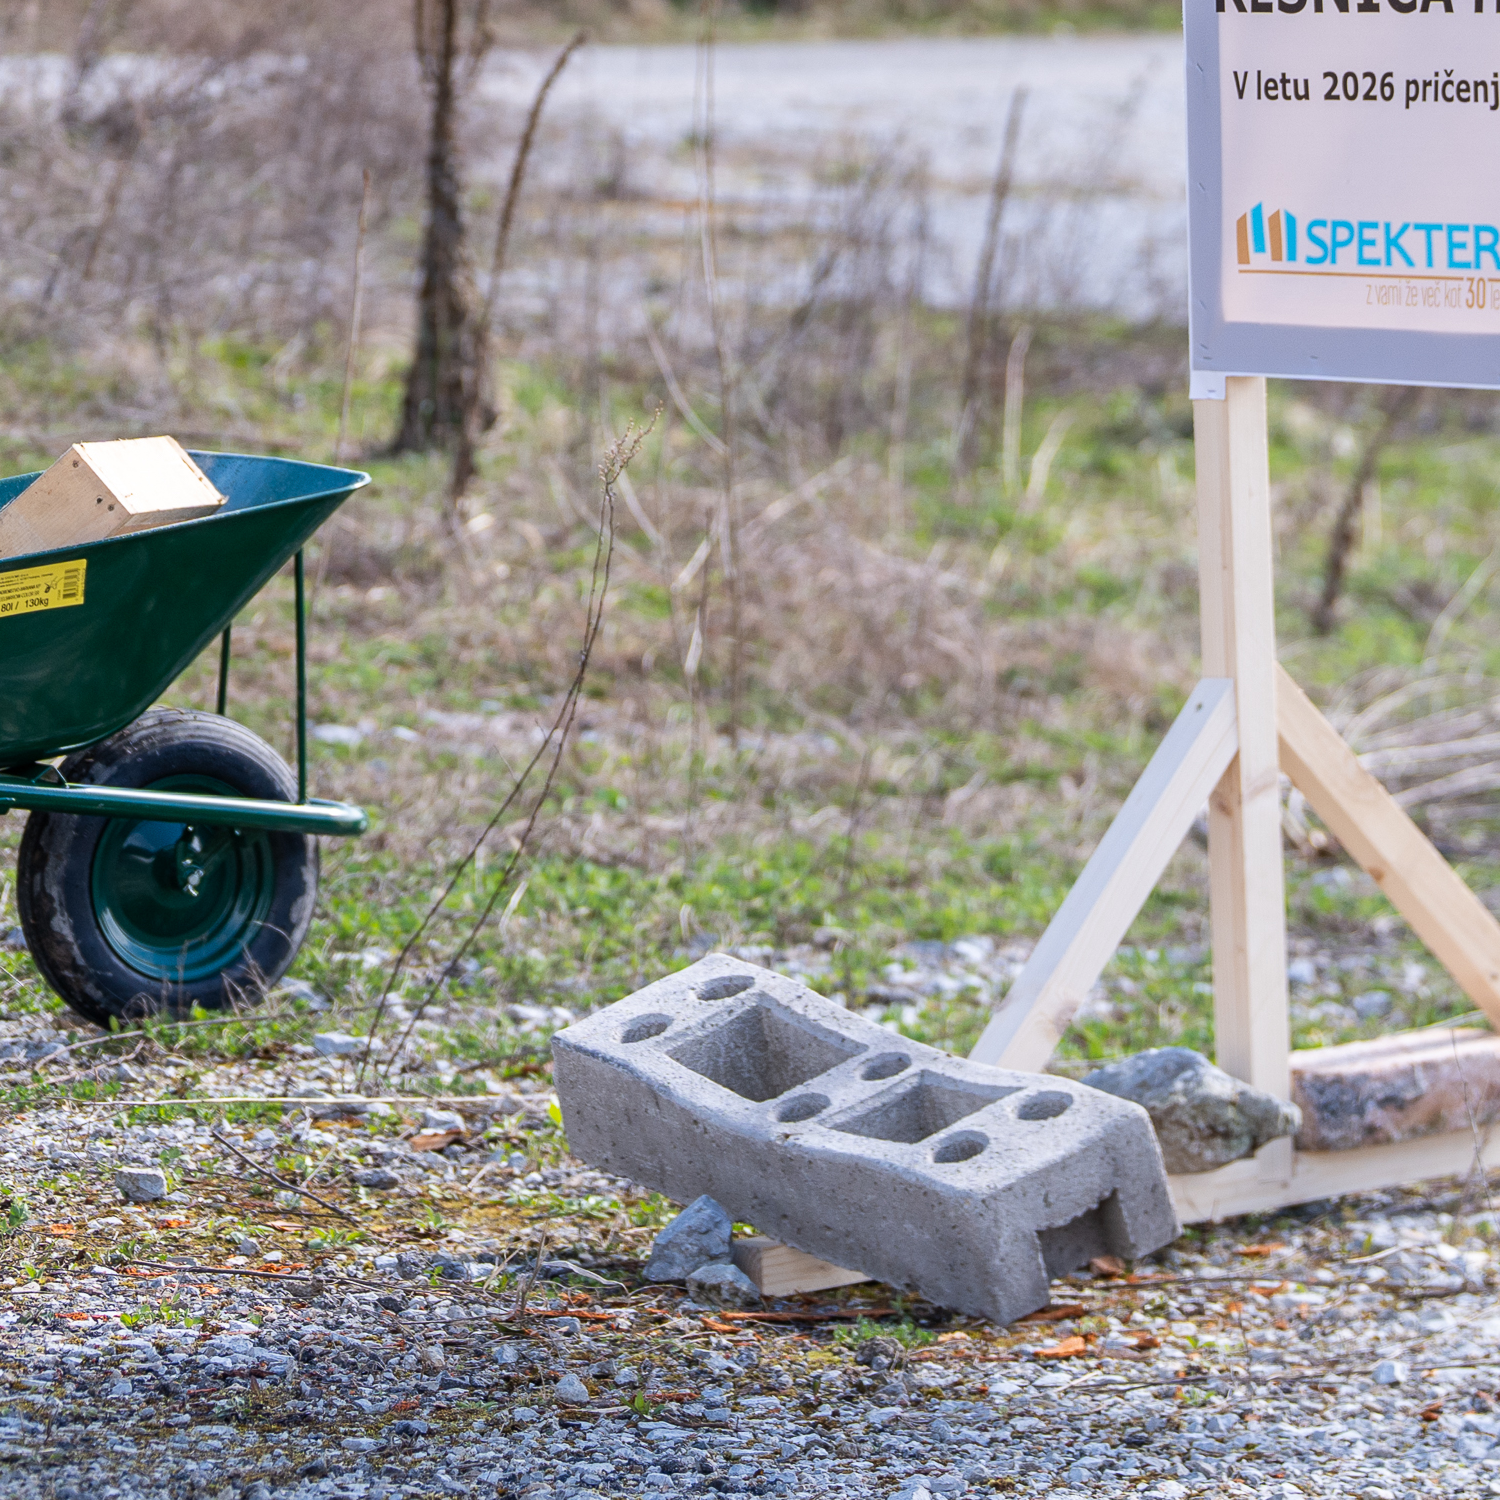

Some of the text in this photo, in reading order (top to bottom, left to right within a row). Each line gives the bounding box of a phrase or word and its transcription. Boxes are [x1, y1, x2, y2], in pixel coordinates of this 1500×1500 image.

[1232, 70, 1249, 100] V
[1256, 69, 1310, 101] letu
[1322, 70, 1395, 102] 2026
[1366, 284, 1373, 305] z
[1375, 279, 1402, 306] vami
[1405, 279, 1418, 307] že
[1421, 280, 1441, 308] več
[1444, 281, 1462, 309] kot
[1465, 277, 1487, 310] 30
[25, 598, 49, 608] 130kg
